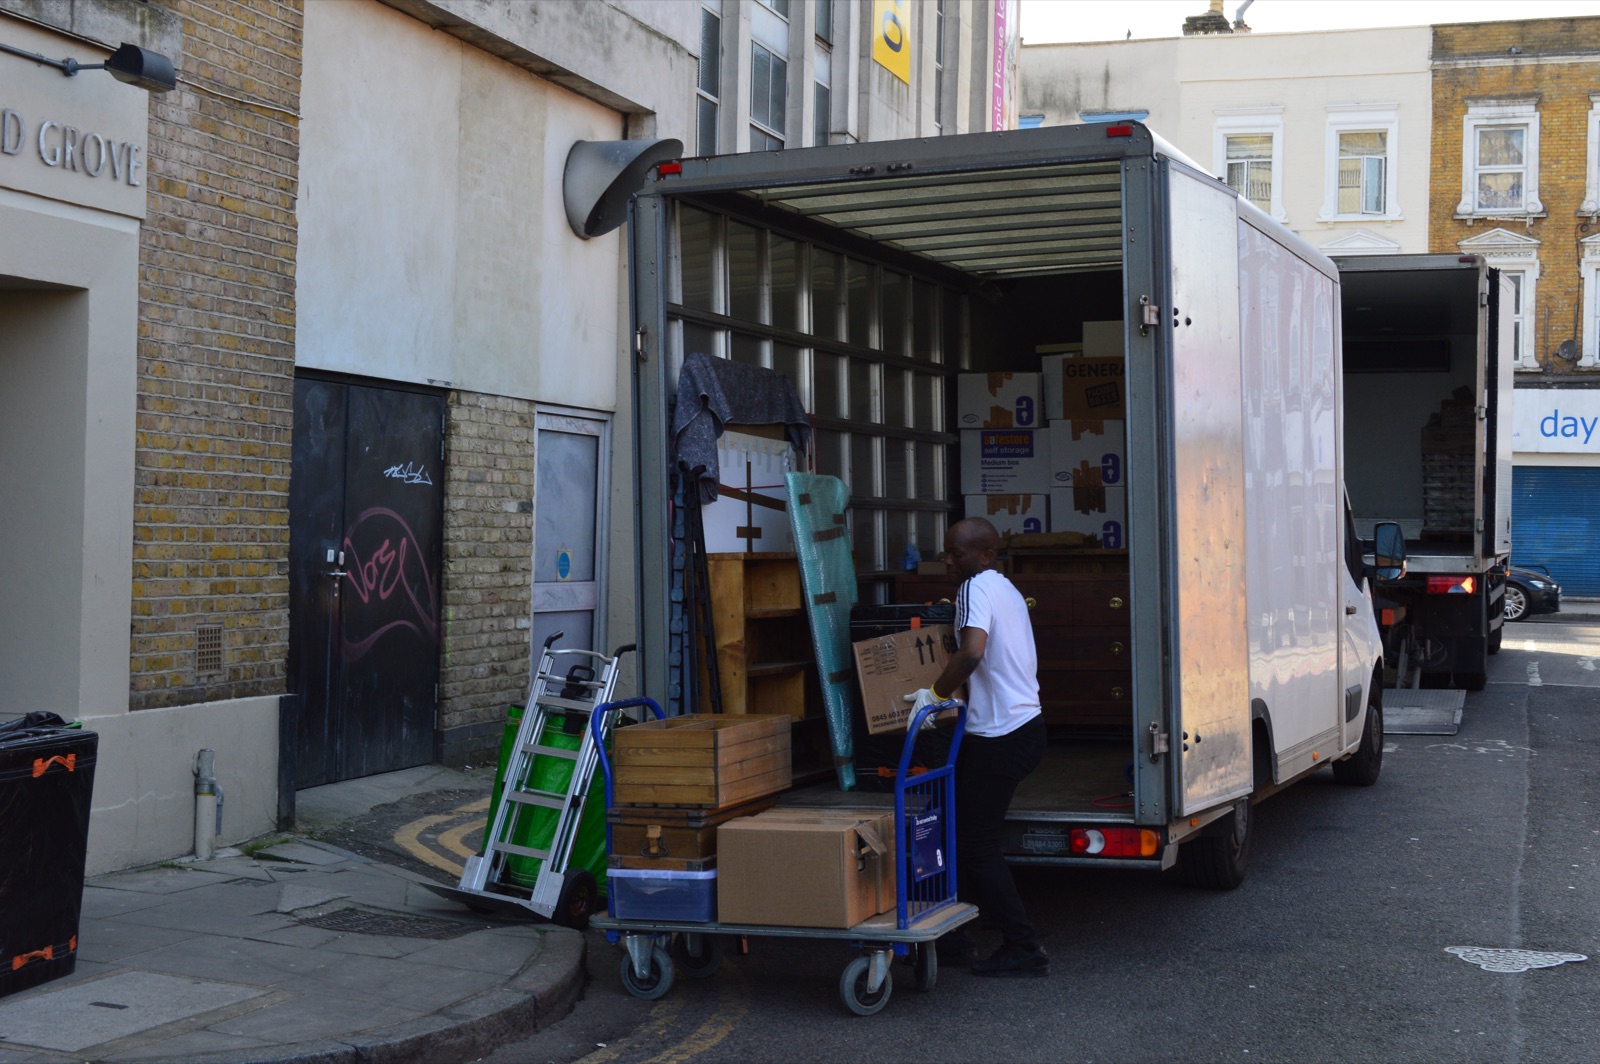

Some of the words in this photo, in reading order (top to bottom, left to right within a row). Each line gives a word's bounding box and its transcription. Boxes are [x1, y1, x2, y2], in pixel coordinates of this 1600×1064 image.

[994, 26, 1004, 89] House
[995, 95, 1003, 132] pic
[2, 108, 26, 156] D
[38, 119, 142, 187] GROVE
[983, 433, 1030, 445] safestore
[1540, 409, 1599, 445] day
[984, 446, 999, 454] self
[1000, 447, 1030, 455] storage
[871, 713, 888, 722] 0845
[888, 710, 900, 719] 600
